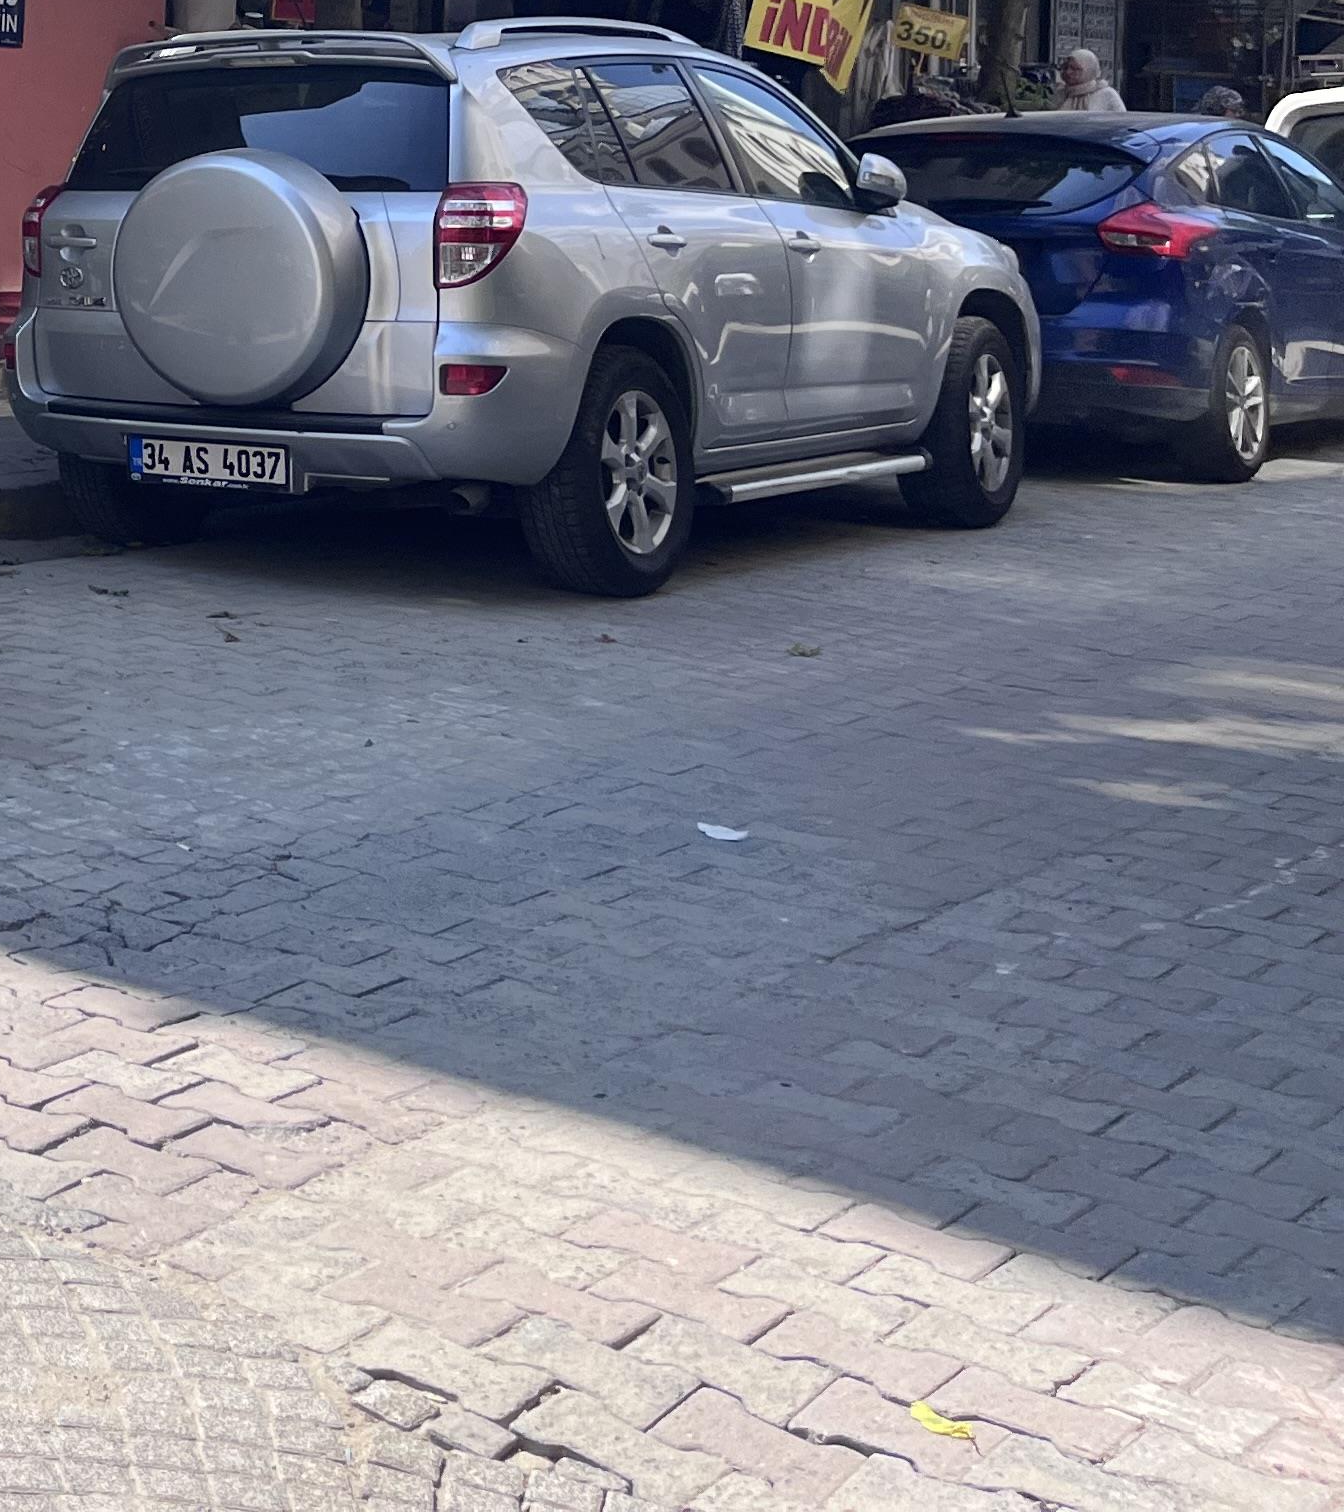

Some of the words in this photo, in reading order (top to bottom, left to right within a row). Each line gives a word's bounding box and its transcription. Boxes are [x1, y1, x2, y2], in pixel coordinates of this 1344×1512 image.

[896, 19, 948, 51] 350
[143, 442, 170, 472] 34
[182, 445, 210, 475] AS
[222, 448, 281, 480] 4037
